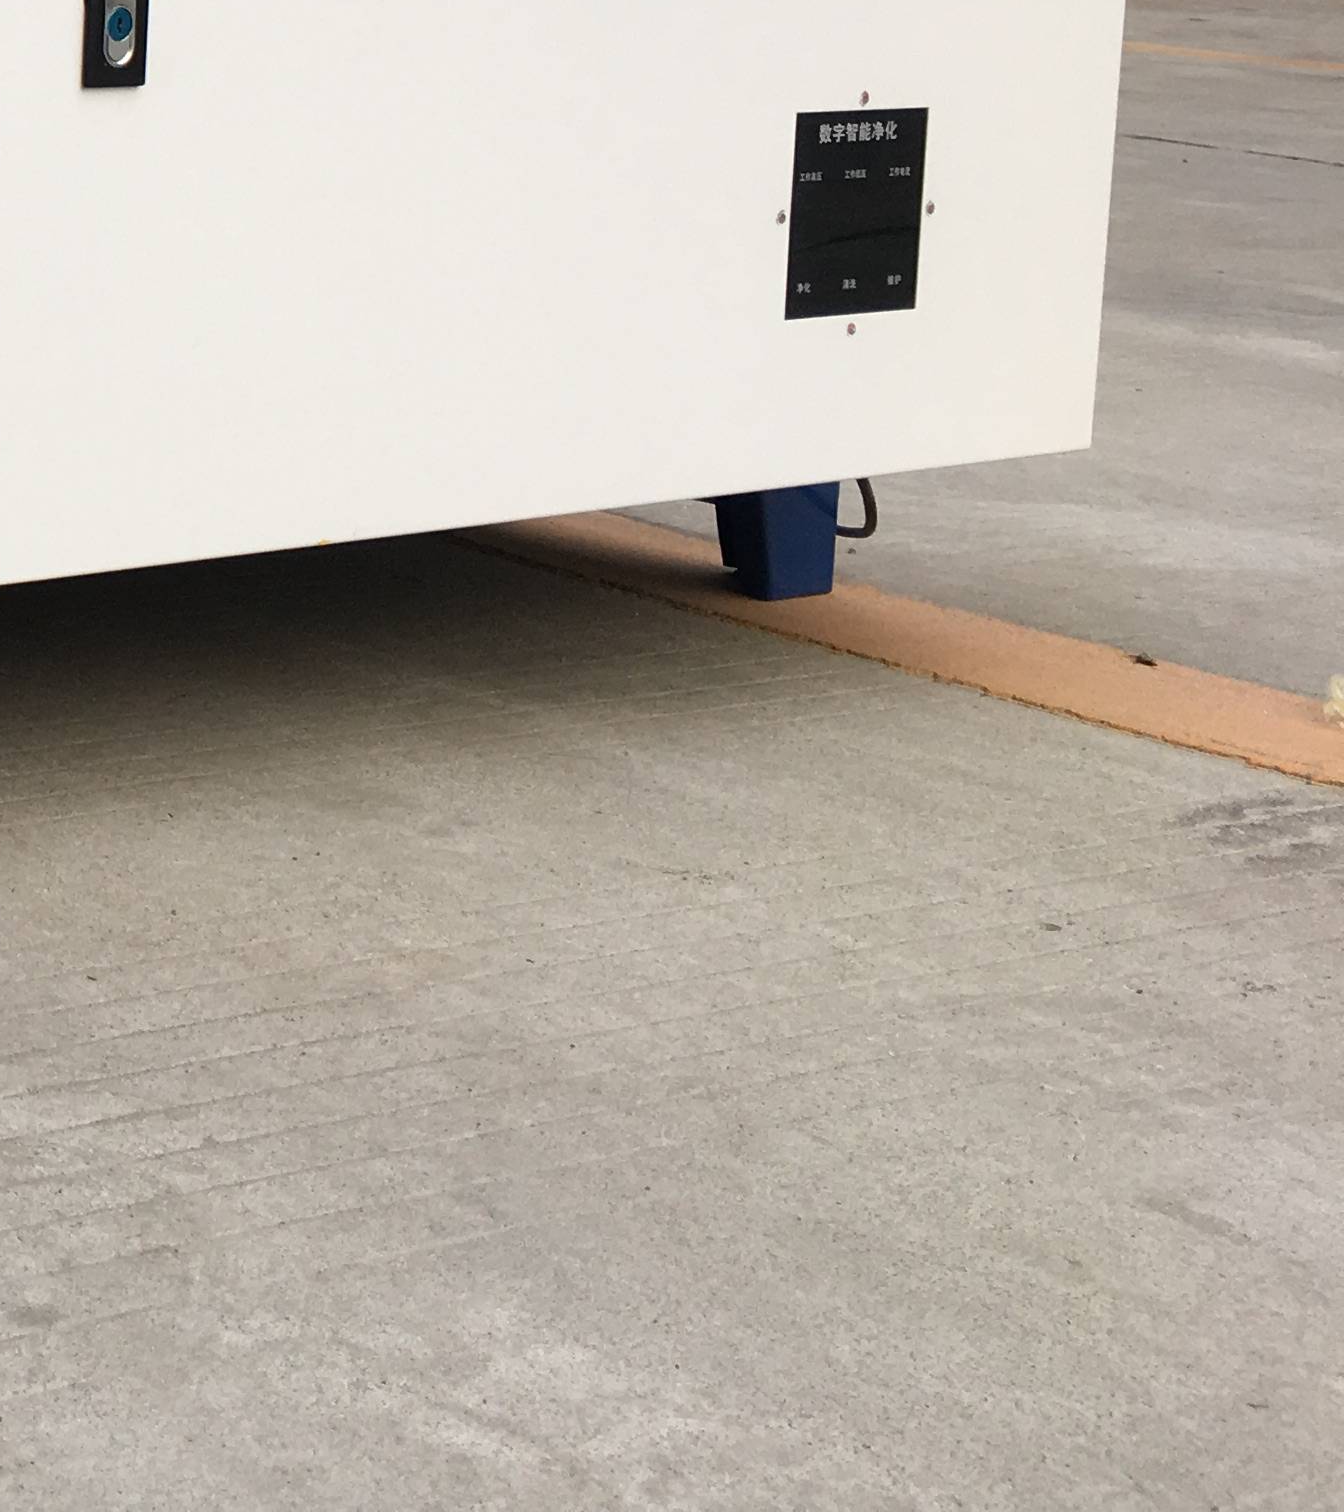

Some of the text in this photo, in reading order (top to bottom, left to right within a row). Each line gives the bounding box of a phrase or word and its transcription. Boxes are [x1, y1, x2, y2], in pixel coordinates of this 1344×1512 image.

[819, 120, 898, 144] 数字智能净化
